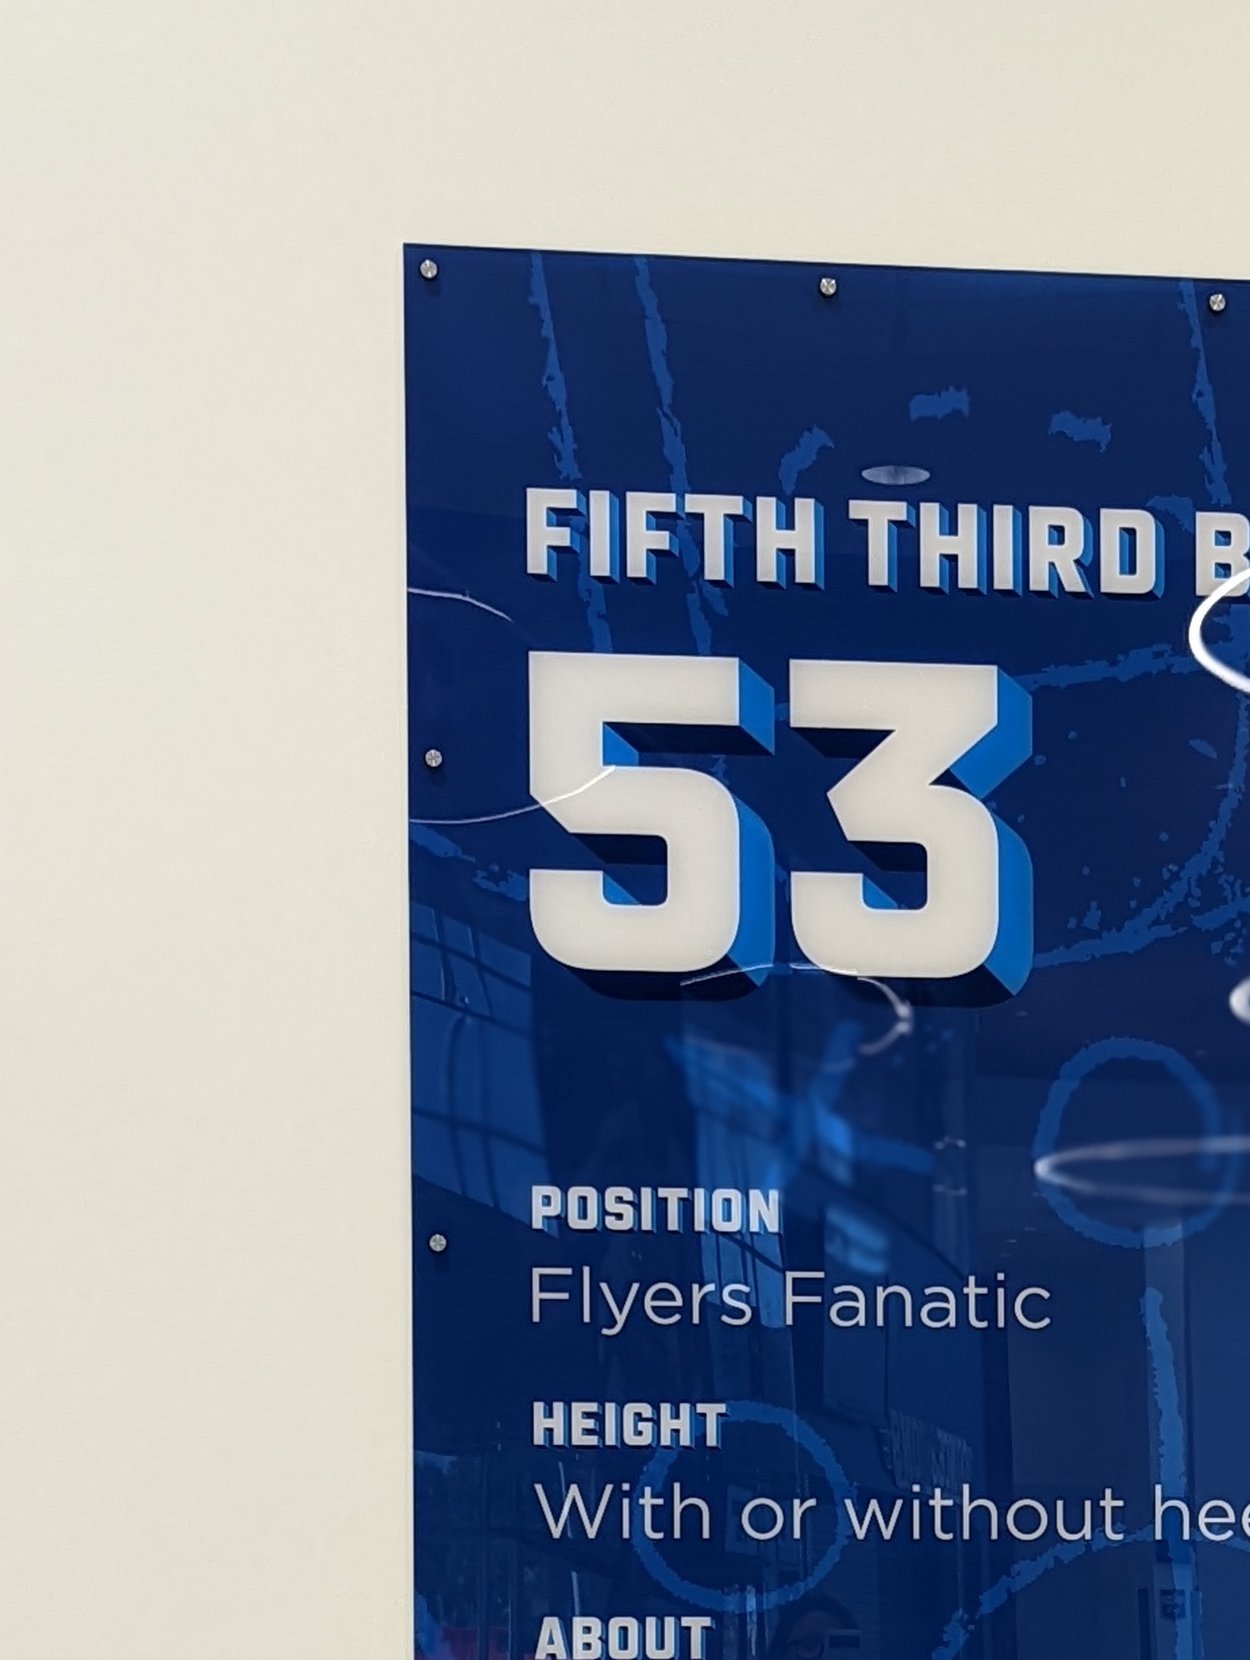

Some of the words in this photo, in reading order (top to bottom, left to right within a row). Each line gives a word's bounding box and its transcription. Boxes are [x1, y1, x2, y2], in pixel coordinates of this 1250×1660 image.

[526, 487, 816, 583] FIFTH
[848, 499, 1156, 594] THIRD
[528, 650, 999, 980] 53
[531, 1185, 779, 1233] POSITION
[532, 1266, 752, 1335] Flyers
[785, 1271, 1050, 1329] Fanatic
[533, 1401, 726, 1447] HEIGHT
[534, 1482, 710, 1539] With
[741, 1498, 816, 1540] or
[844, 1483, 1124, 1541] without
[534, 1616, 711, 1660] ABOUT
